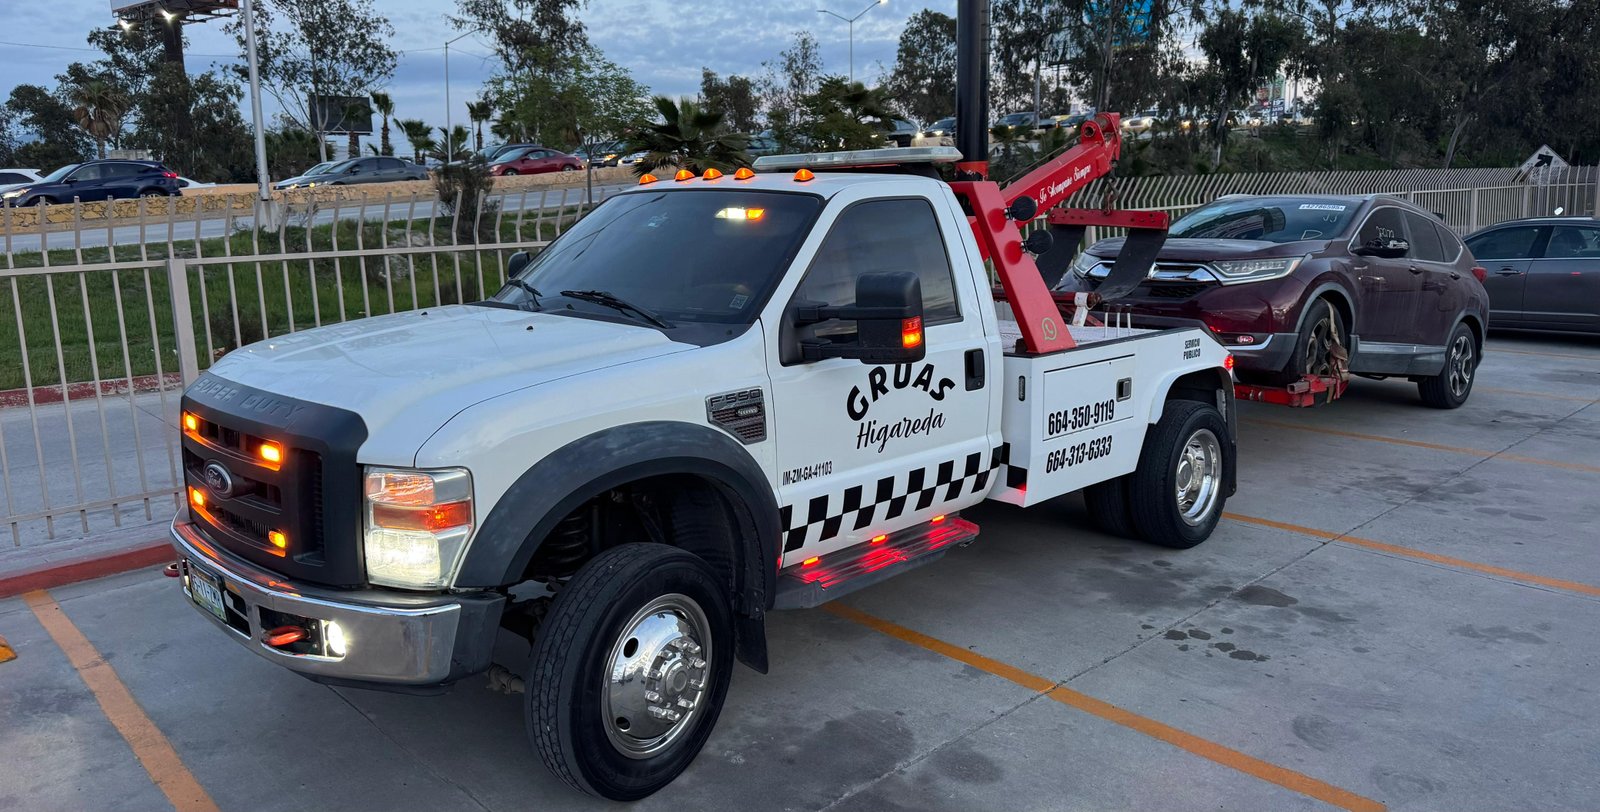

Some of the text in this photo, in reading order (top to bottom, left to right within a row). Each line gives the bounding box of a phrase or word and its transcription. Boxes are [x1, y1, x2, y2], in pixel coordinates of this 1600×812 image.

[194, 378, 305, 418] SUPER DUTY
[847, 363, 956, 421] GRUAS
[857, 408, 946, 454] Higareda
[1048, 399, 1115, 436] 664-350-9119
[782, 460, 833, 486] IM-ZM-GA-41103
[1046, 435, 1113, 474] 664-313-6333
